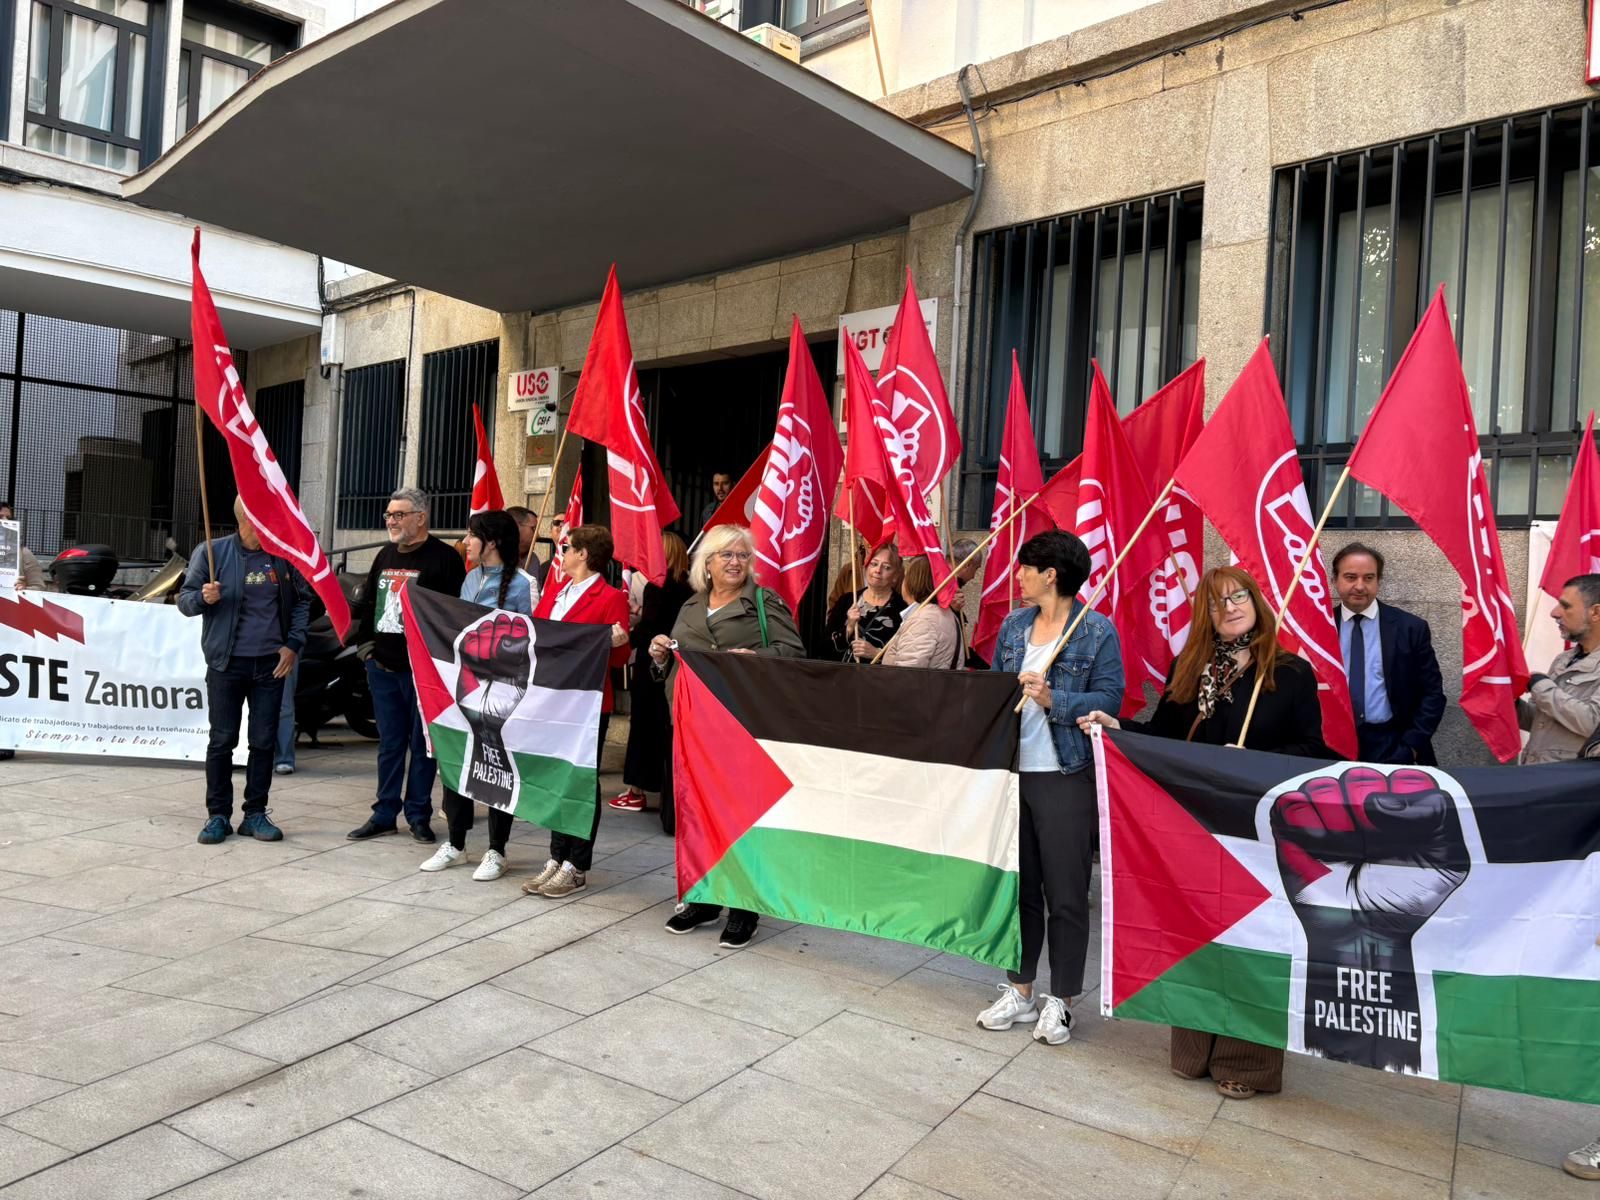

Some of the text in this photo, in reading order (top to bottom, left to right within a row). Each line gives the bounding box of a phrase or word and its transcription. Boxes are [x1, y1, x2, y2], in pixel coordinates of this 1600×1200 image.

[852, 328, 880, 351] GT
[517, 371, 549, 396] USO
[84, 670, 204, 710] Zamora
[22, 716, 32, 725] de
[34, 717, 80, 728] trabajadoras
[87, 721, 134, 731] trabajadores
[135, 724, 146, 732] de
[147, 724, 155, 732] la
[156, 724, 195, 734] Enseñanza
[25, 729, 167, 746] Siempre a tu lado
[482, 742, 503, 767] FREE
[472, 760, 513, 791] PALESTINE
[1336, 966, 1393, 1004] FREE
[1314, 999, 1418, 1042] PALESTINE
